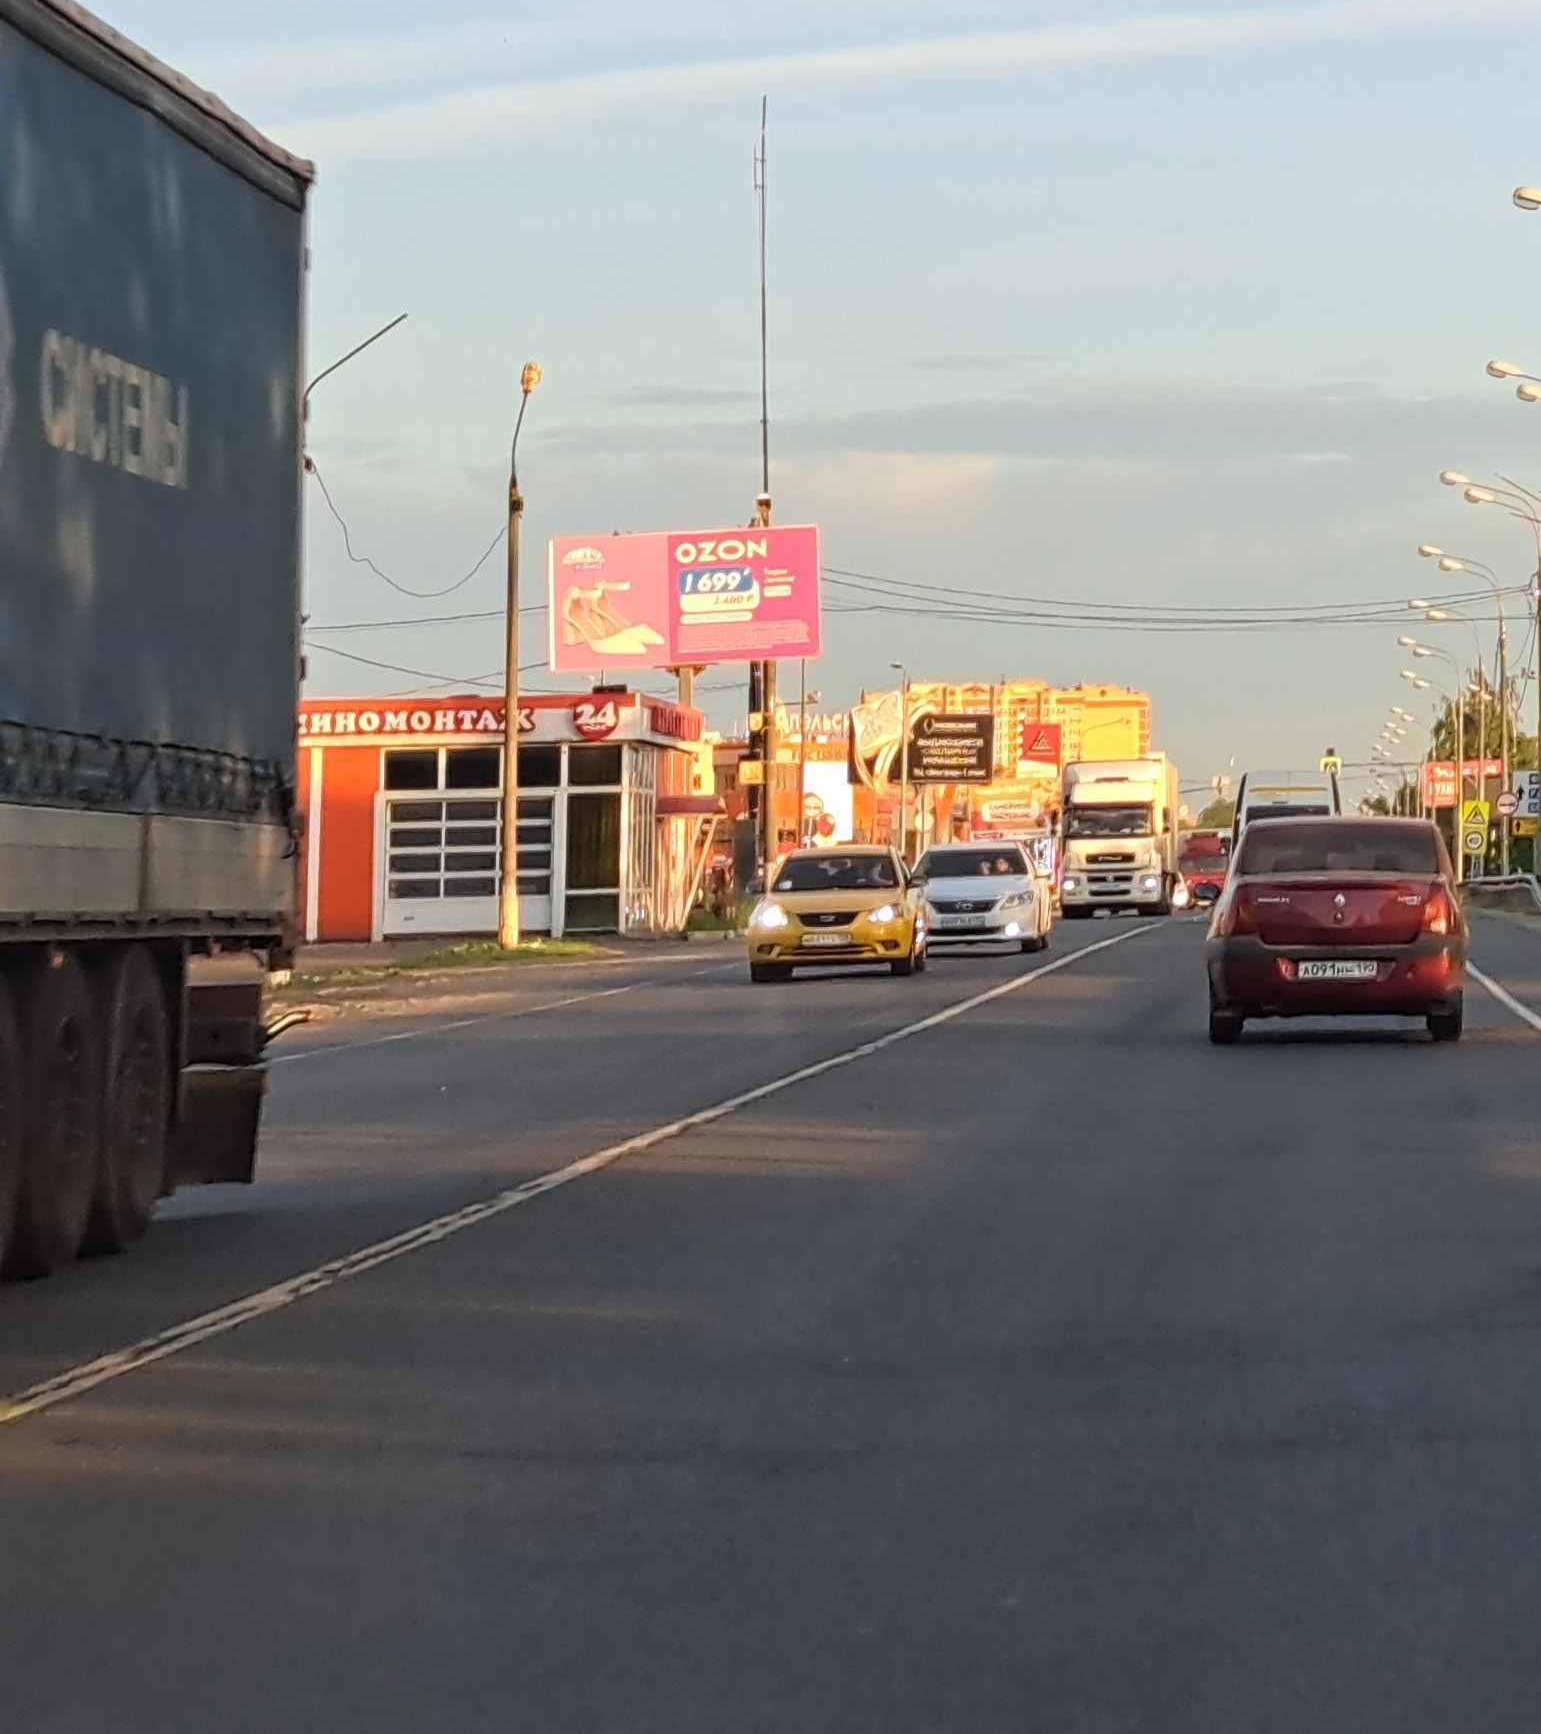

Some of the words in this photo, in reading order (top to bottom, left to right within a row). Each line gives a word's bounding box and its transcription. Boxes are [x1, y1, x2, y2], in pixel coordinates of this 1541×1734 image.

[675, 537, 768, 564] OZON
[298, 707, 534, 735] ИНОМОНТАЖ
[576, 700, 617, 727] 24
